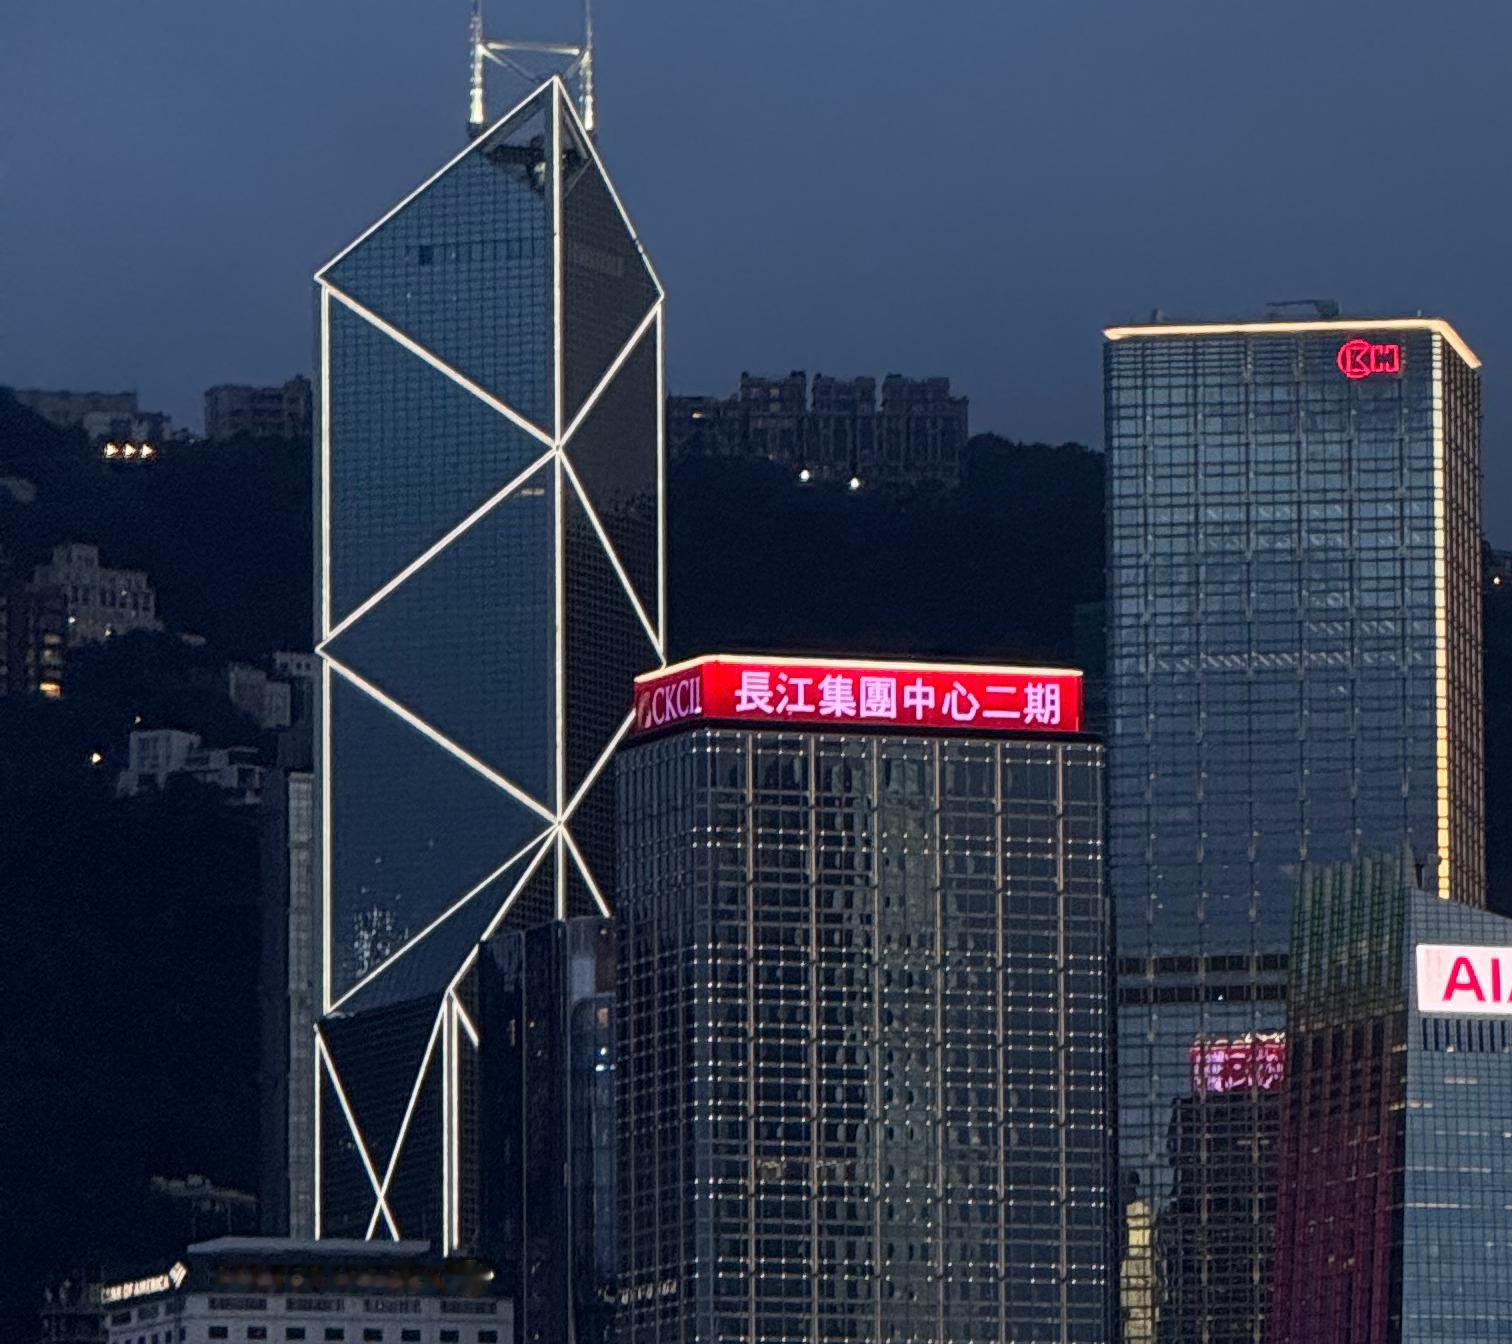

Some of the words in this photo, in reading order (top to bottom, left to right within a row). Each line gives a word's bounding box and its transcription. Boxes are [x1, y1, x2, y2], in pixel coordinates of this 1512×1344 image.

[735, 672, 1060, 724] 長江集團中心二期
